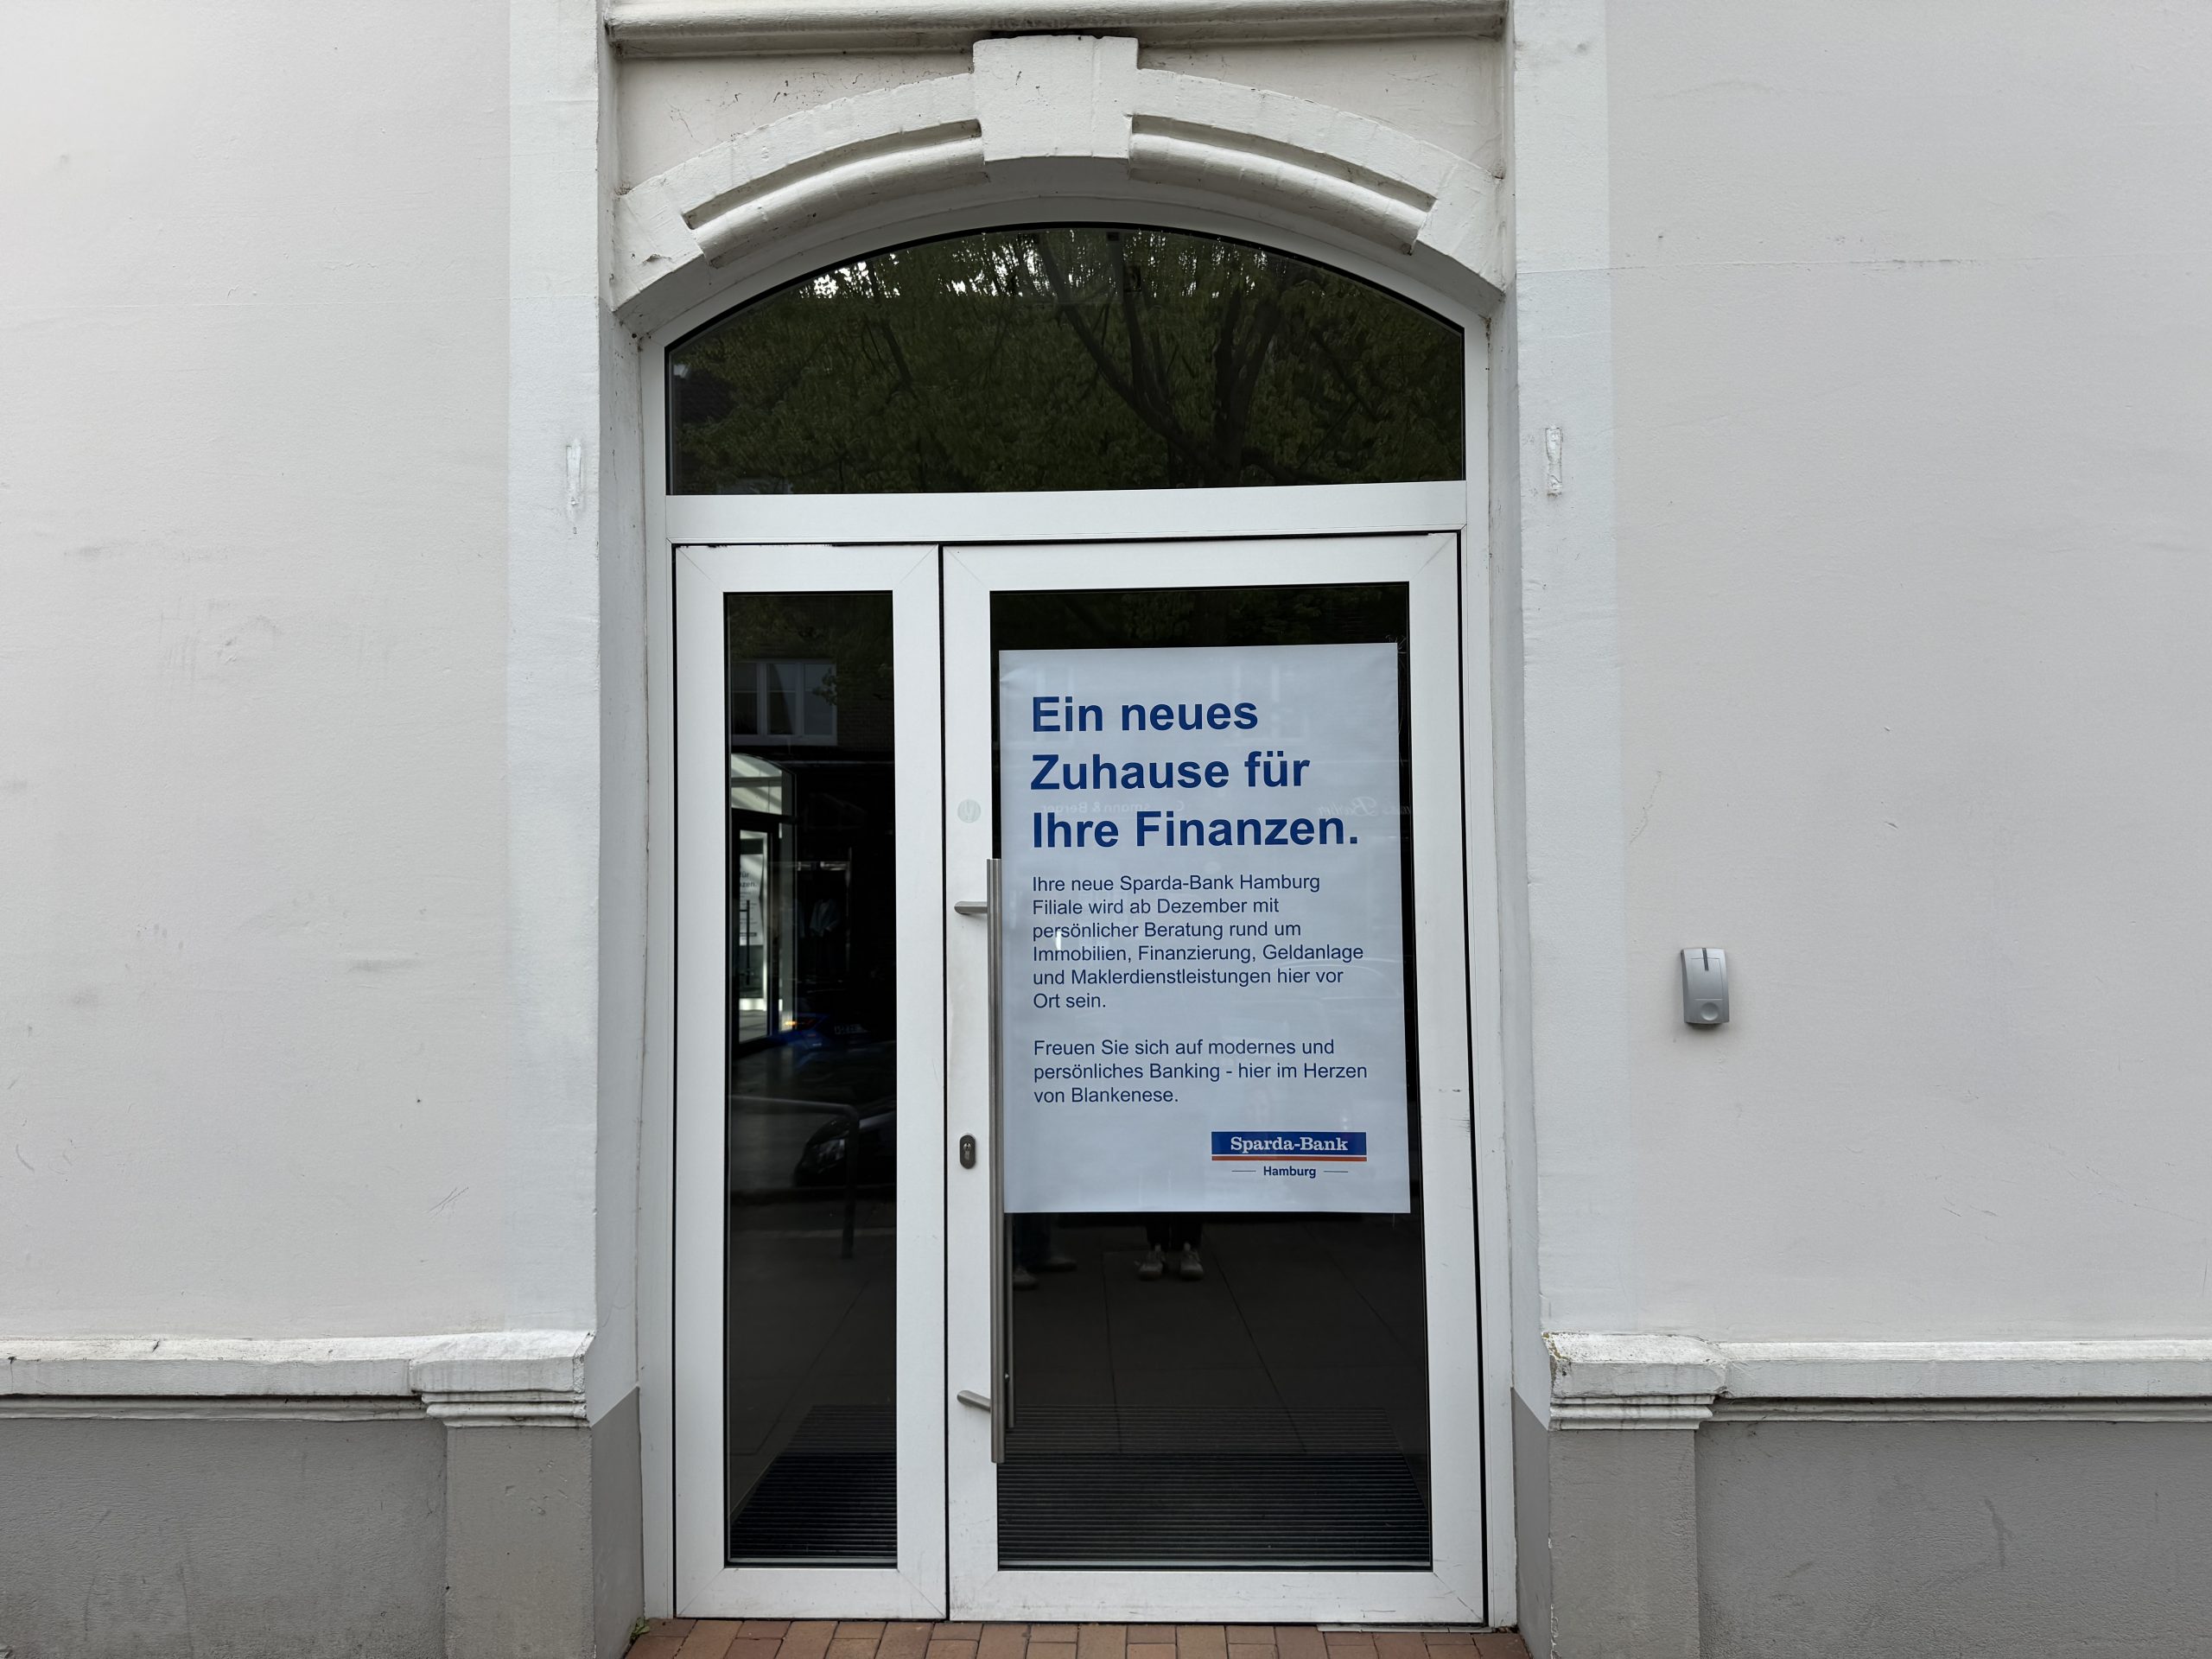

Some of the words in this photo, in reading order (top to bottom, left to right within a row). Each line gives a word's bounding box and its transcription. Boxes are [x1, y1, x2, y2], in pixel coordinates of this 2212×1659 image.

[1033, 696, 1103, 733] Ein
[1122, 702, 1258, 732] neues
[1030, 753, 1230, 791] Zuhause
[1243, 750, 1311, 788] für
[1033, 811, 1119, 849] Ihre
[1136, 810, 1358, 847] Finanzen.
[1033, 876, 1065, 892] Ihre
[1071, 879, 1115, 892] neue
[1120, 874, 1235, 895] Sparda-Bank
[1240, 874, 1320, 893] Hamburg
[1033, 899, 1084, 915] Filiale
[1088, 899, 1123, 914] wird
[1129, 898, 1151, 914] ab
[1157, 897, 1248, 914] Dezember
[1253, 897, 1280, 913] mit
[1033, 922, 1140, 943] persönlicher
[1144, 921, 1224, 941] Beratung
[1230, 920, 1268, 937] rund
[1274, 924, 1301, 937] um
[1033, 945, 1132, 963] Immobilien,
[1138, 944, 1256, 964] Finanzierung,
[1262, 944, 1363, 963] Geldanlage
[1033, 969, 1065, 985] und
[1071, 968, 1271, 988] Maklerdienstleistungen
[1277, 967, 1311, 983] hier
[1315, 970, 1344, 983] vor
[1033, 993, 1061, 1009] Ort
[1065, 992, 1106, 1008] sein.
[1034, 1039, 1095, 1056] Freuen
[1101, 1039, 1129, 1055] Sie
[1135, 1039, 1169, 1055] sich
[1175, 1039, 1204, 1055] auf
[1208, 1039, 1296, 1055] modernes
[1302, 1038, 1334, 1055] und
[1033, 1063, 1144, 1084] persönliches
[1149, 1062, 1220, 1083] Banking
[1238, 1062, 1272, 1078] hier
[1276, 1062, 1297, 1078] im
[1304, 1062, 1368, 1078] Herzen
[1033, 1090, 1065, 1103] von
[1071, 1086, 1179, 1103] Blankenese.
[1230, 1136, 1349, 1154] Sparda-Bank
[1263, 1165, 1317, 1179] Hamburg
